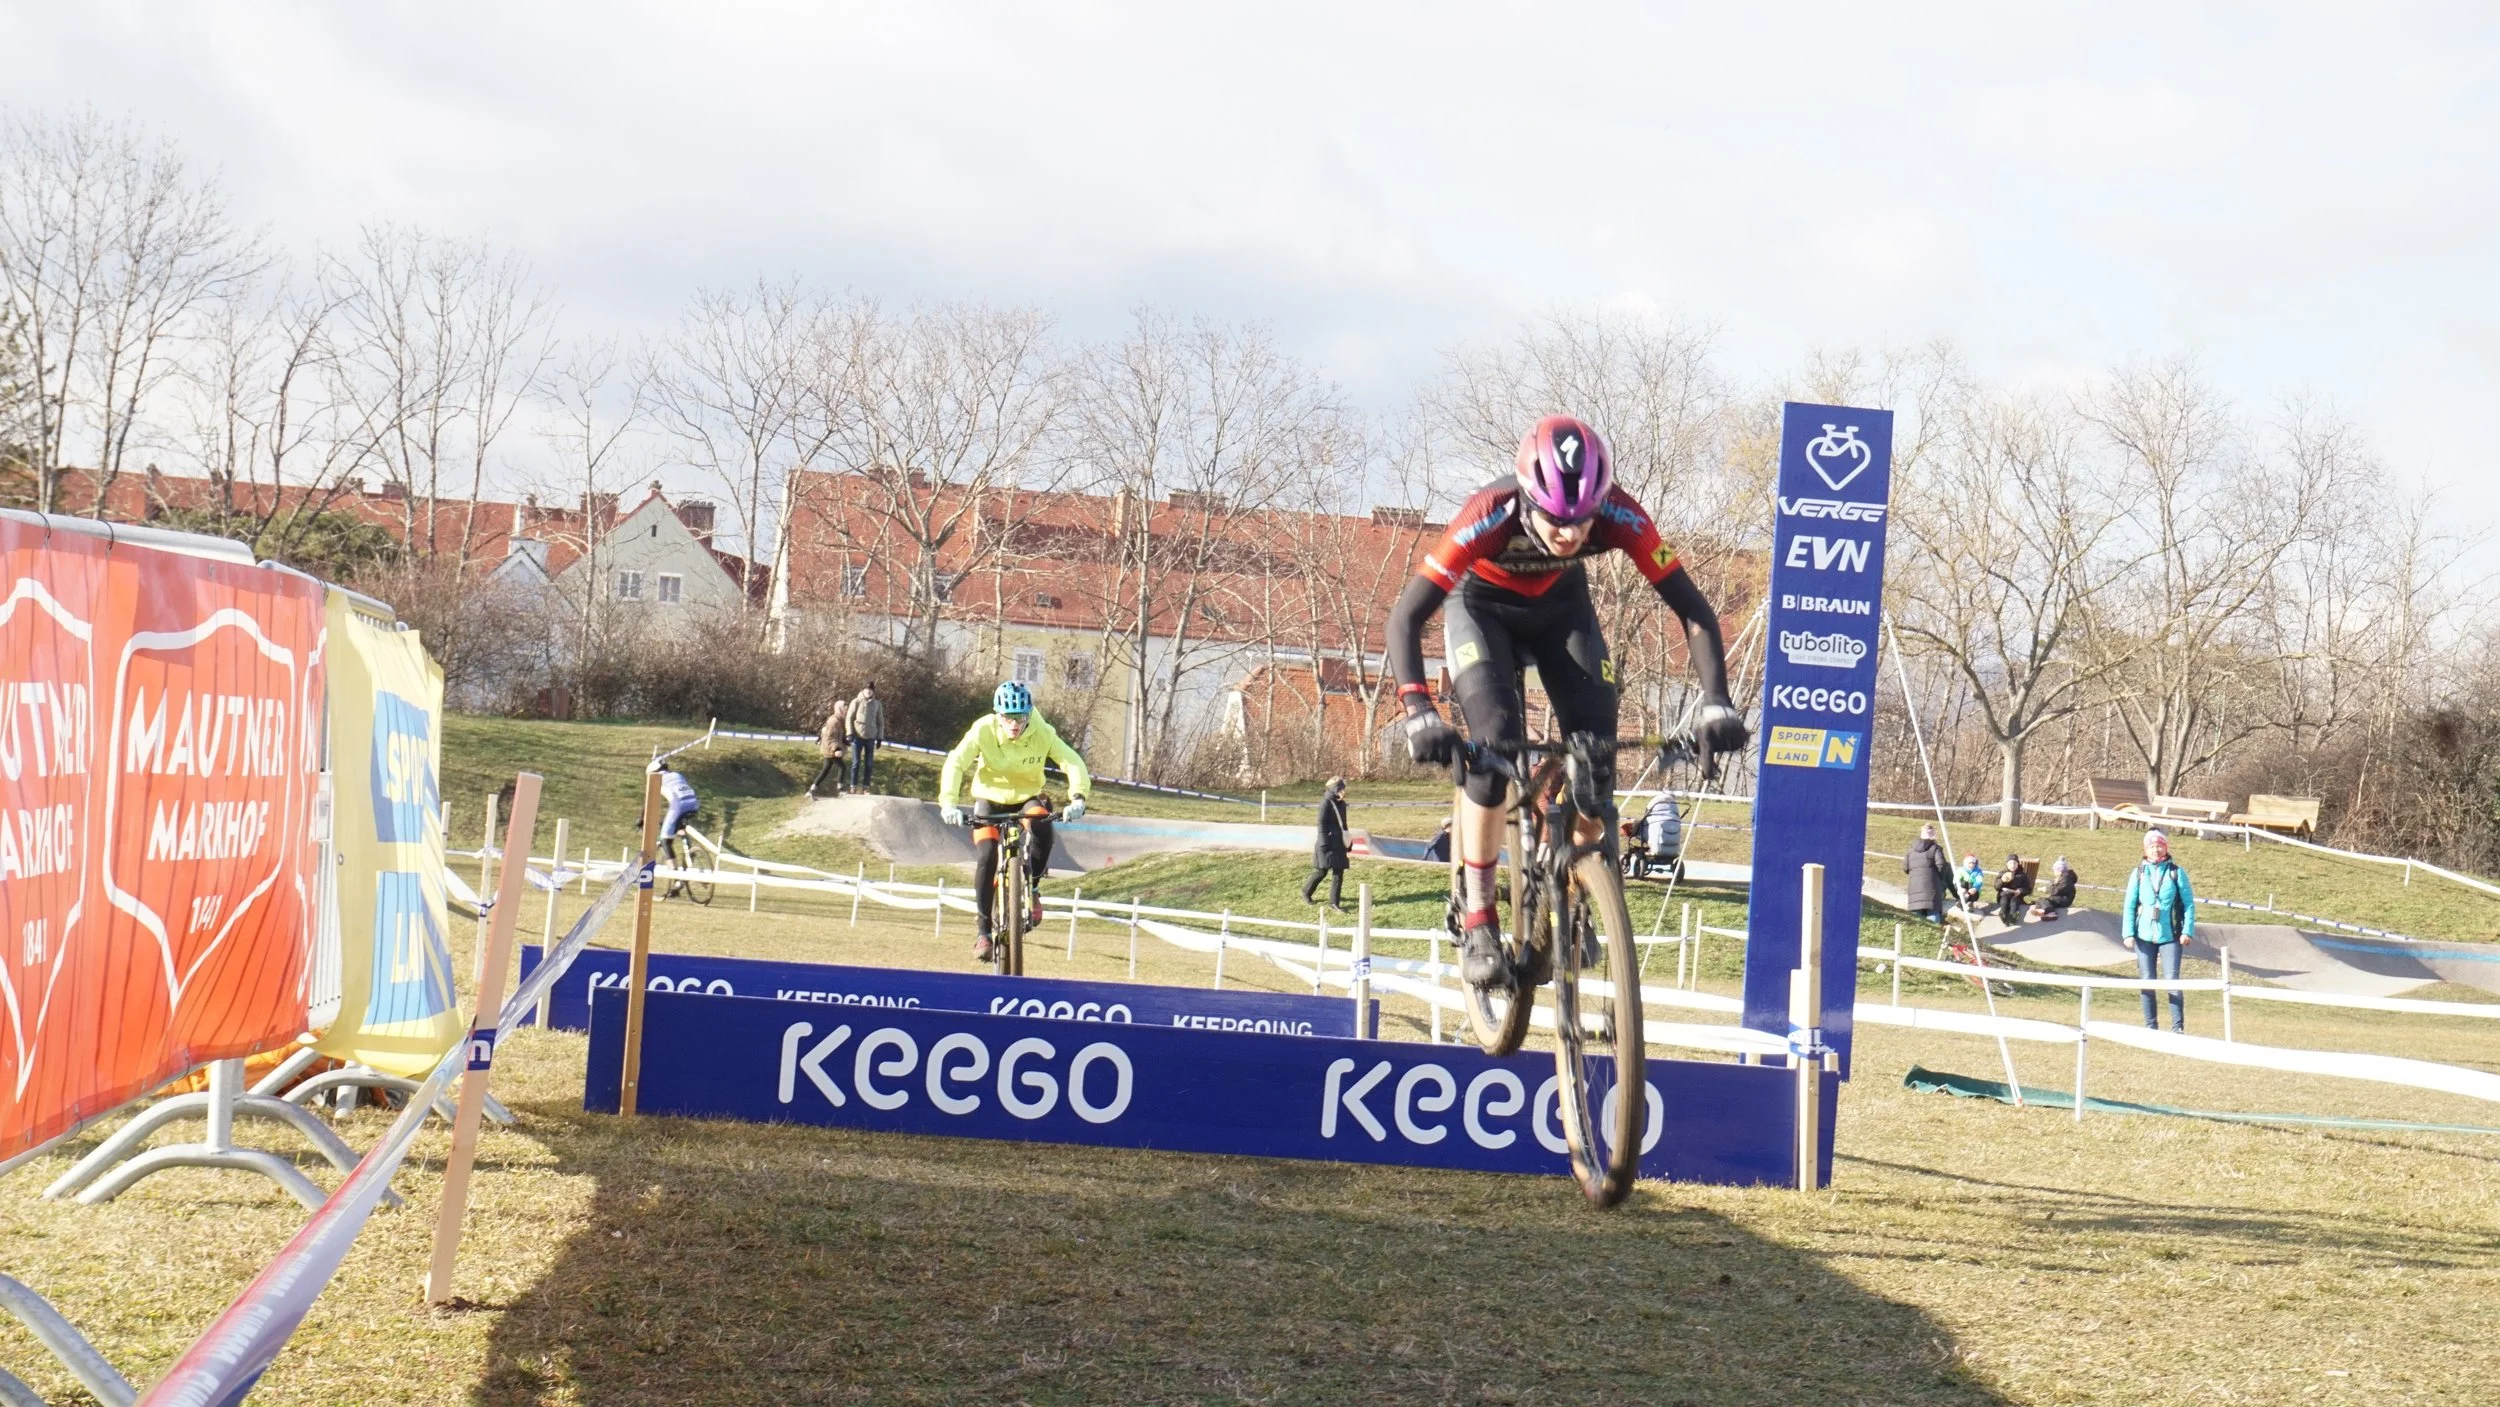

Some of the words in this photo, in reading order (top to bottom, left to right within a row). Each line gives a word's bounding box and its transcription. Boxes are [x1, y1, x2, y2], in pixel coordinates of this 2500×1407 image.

[1778, 496, 1887, 522] VERGE
[1785, 535, 1871, 573] EVN
[1783, 633, 1864, 655] tubolito
[126, 685, 285, 779] MAUTNER
[1778, 732, 1818, 743] SPORT
[1022, 756, 1042, 765] FOX
[1776, 752, 1809, 762] LAND
[147, 800, 270, 863] MARKHOF
[22, 918, 47, 967] 1841
